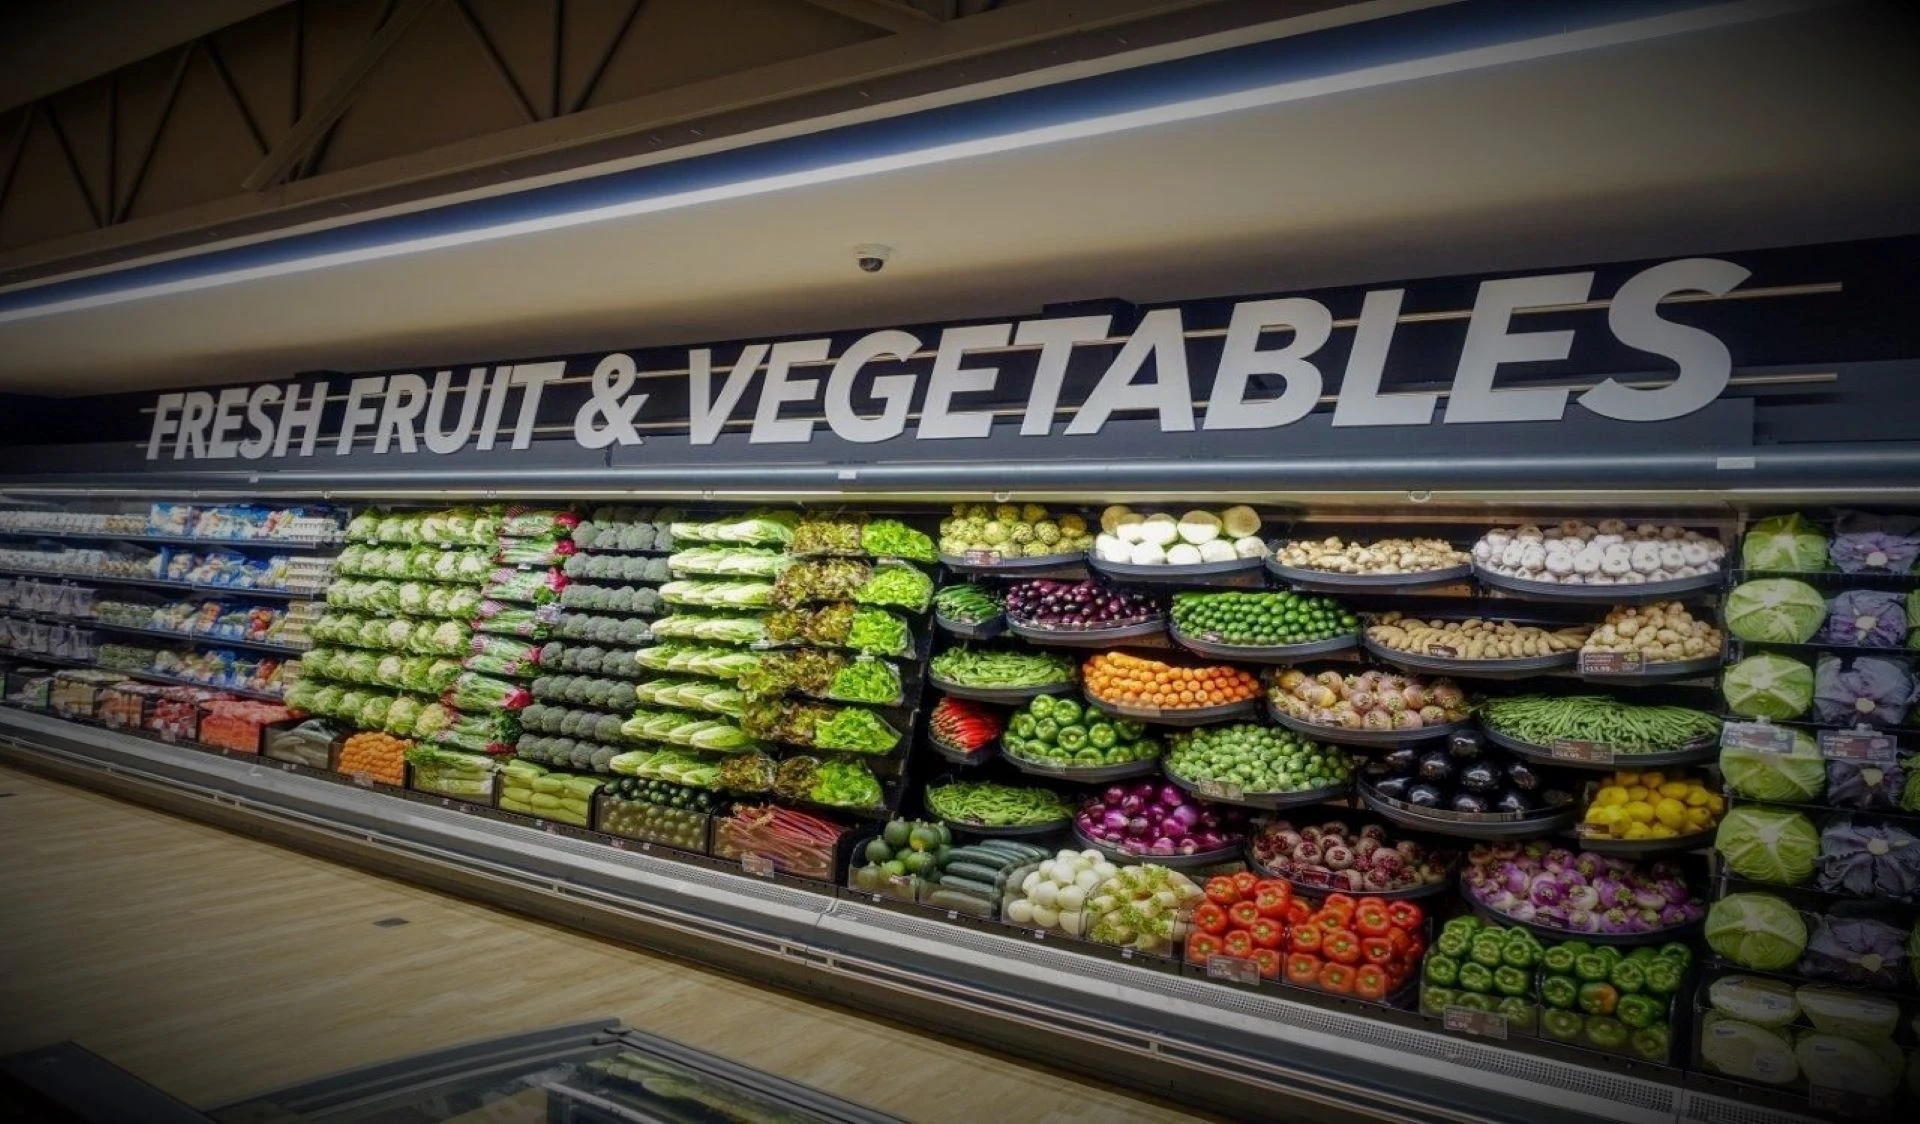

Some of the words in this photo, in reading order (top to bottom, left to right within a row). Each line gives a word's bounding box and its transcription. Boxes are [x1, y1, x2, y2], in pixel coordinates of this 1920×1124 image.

[146, 381, 330, 461] FRESH
[336, 361, 566, 456] FRUIT
[574, 353, 649, 449] &
[687, 258, 1751, 446] VEGETABLES
